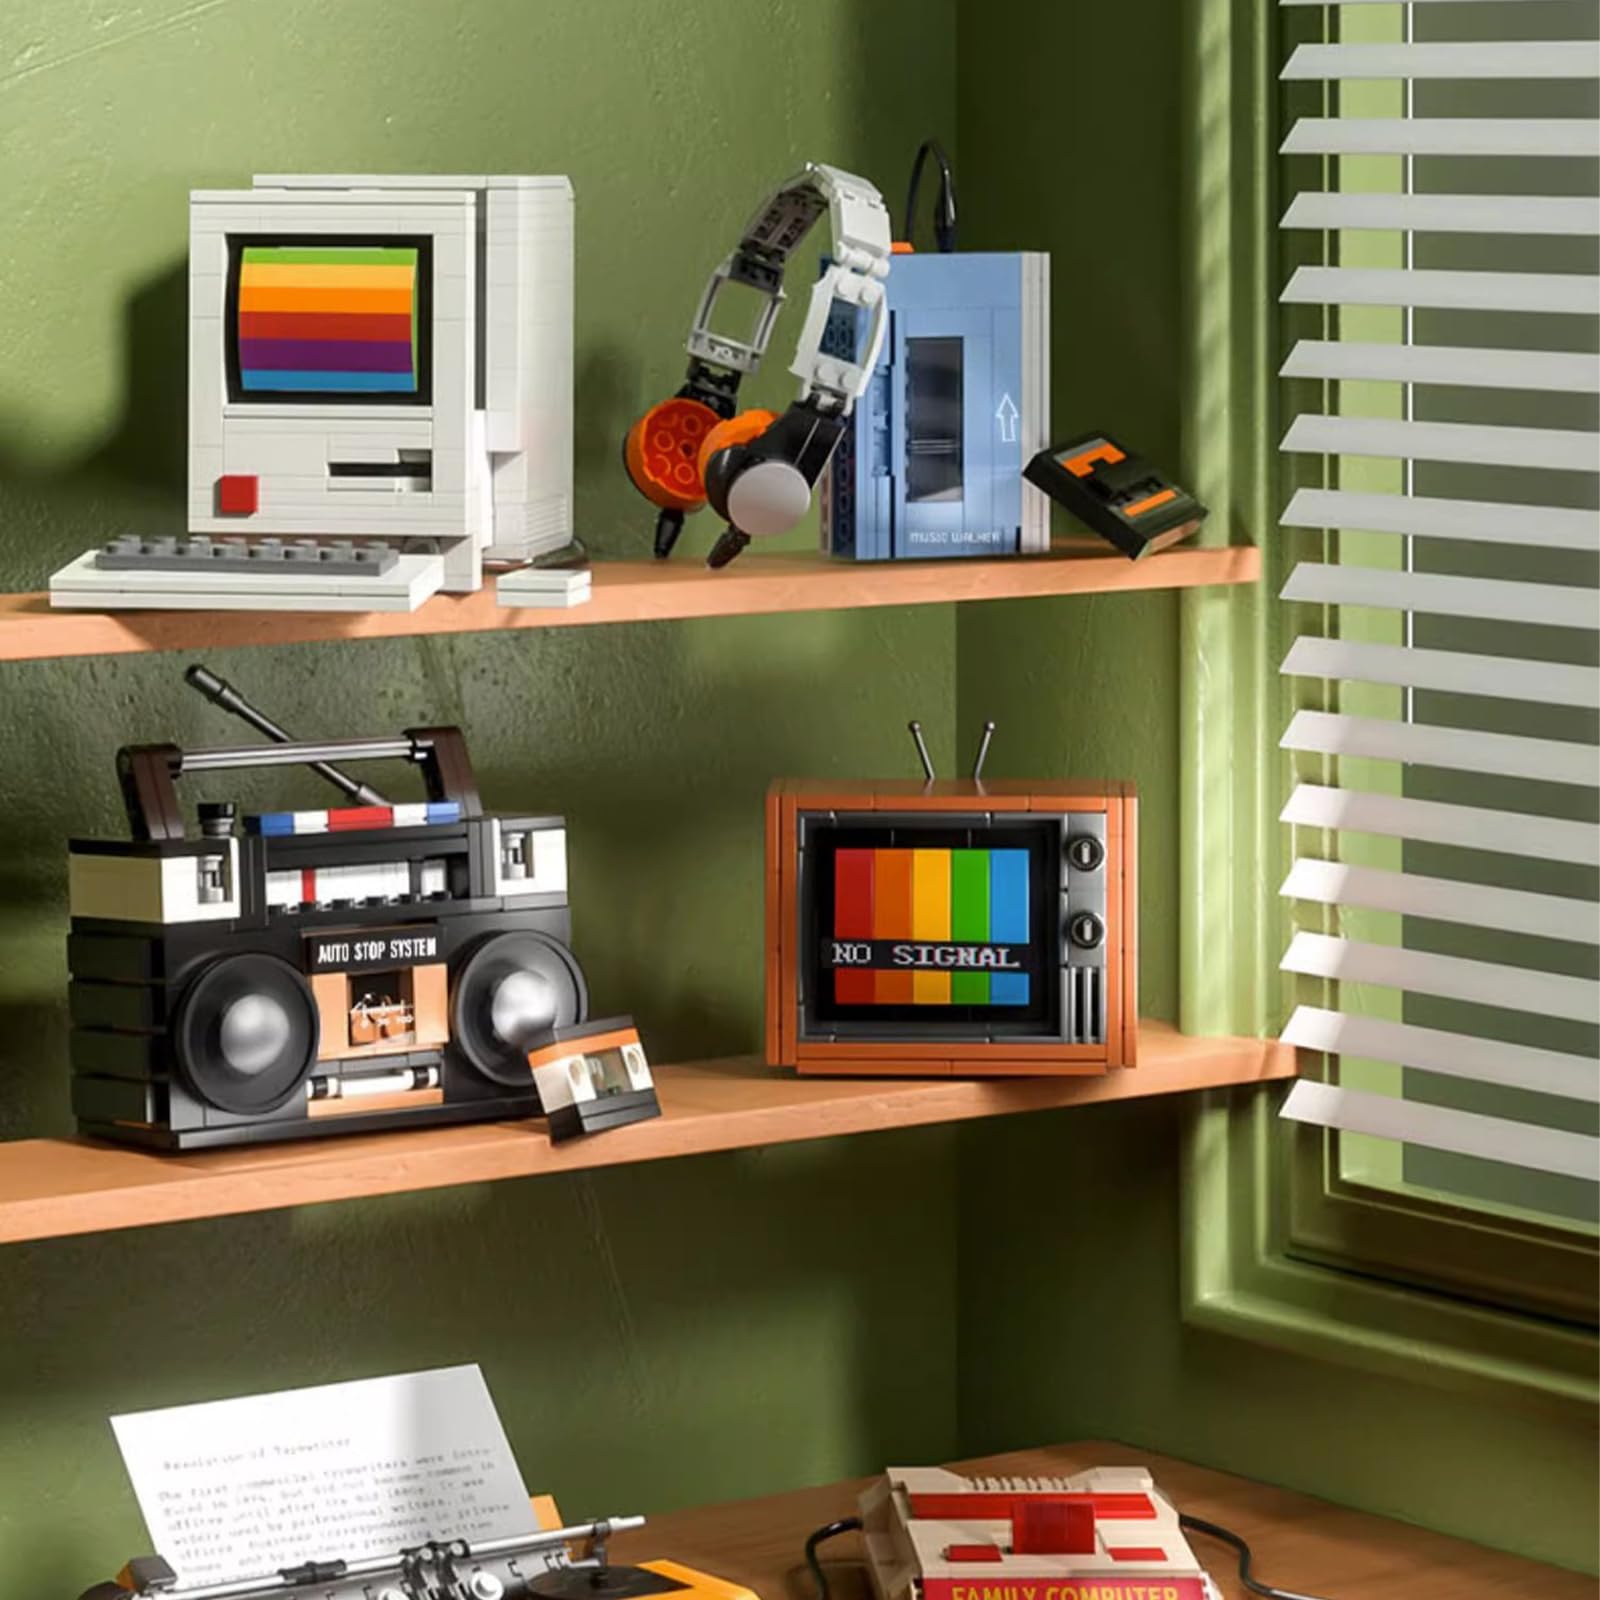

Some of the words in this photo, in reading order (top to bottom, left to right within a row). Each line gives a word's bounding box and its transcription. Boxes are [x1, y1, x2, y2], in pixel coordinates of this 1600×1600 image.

[318, 943, 349, 964] AUTO
[354, 940, 386, 961] STOP
[390, 936, 437, 959] SYSTEM
[832, 942, 871, 964] NO
[893, 944, 1021, 967] SIGNAL
